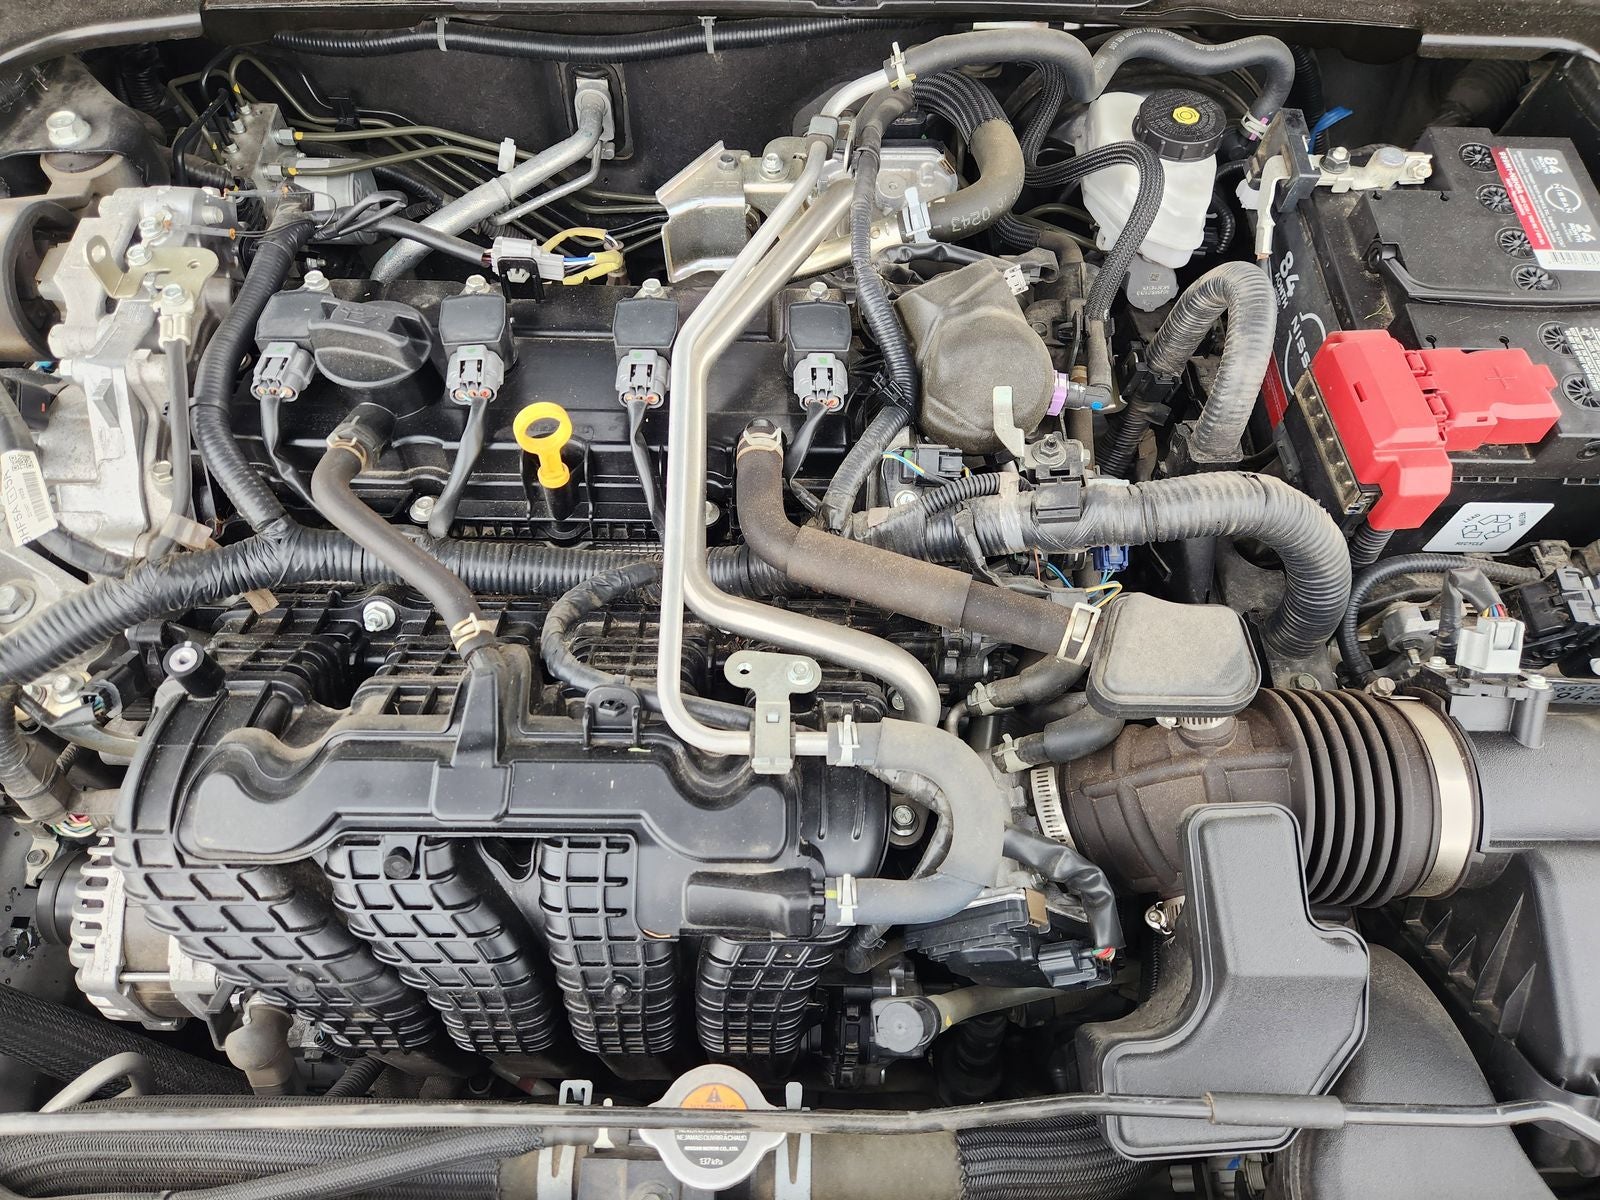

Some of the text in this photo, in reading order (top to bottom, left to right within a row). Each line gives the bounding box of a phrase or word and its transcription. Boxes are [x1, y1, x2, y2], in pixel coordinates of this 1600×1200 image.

[1543, 156, 1563, 174] 84
[1553, 183, 1573, 214] NISSAN
[951, 206, 990, 232] 0243
[1576, 224, 1597, 243] 24
[1280, 251, 1299, 298] 84
[1291, 315, 1310, 369] NISS
